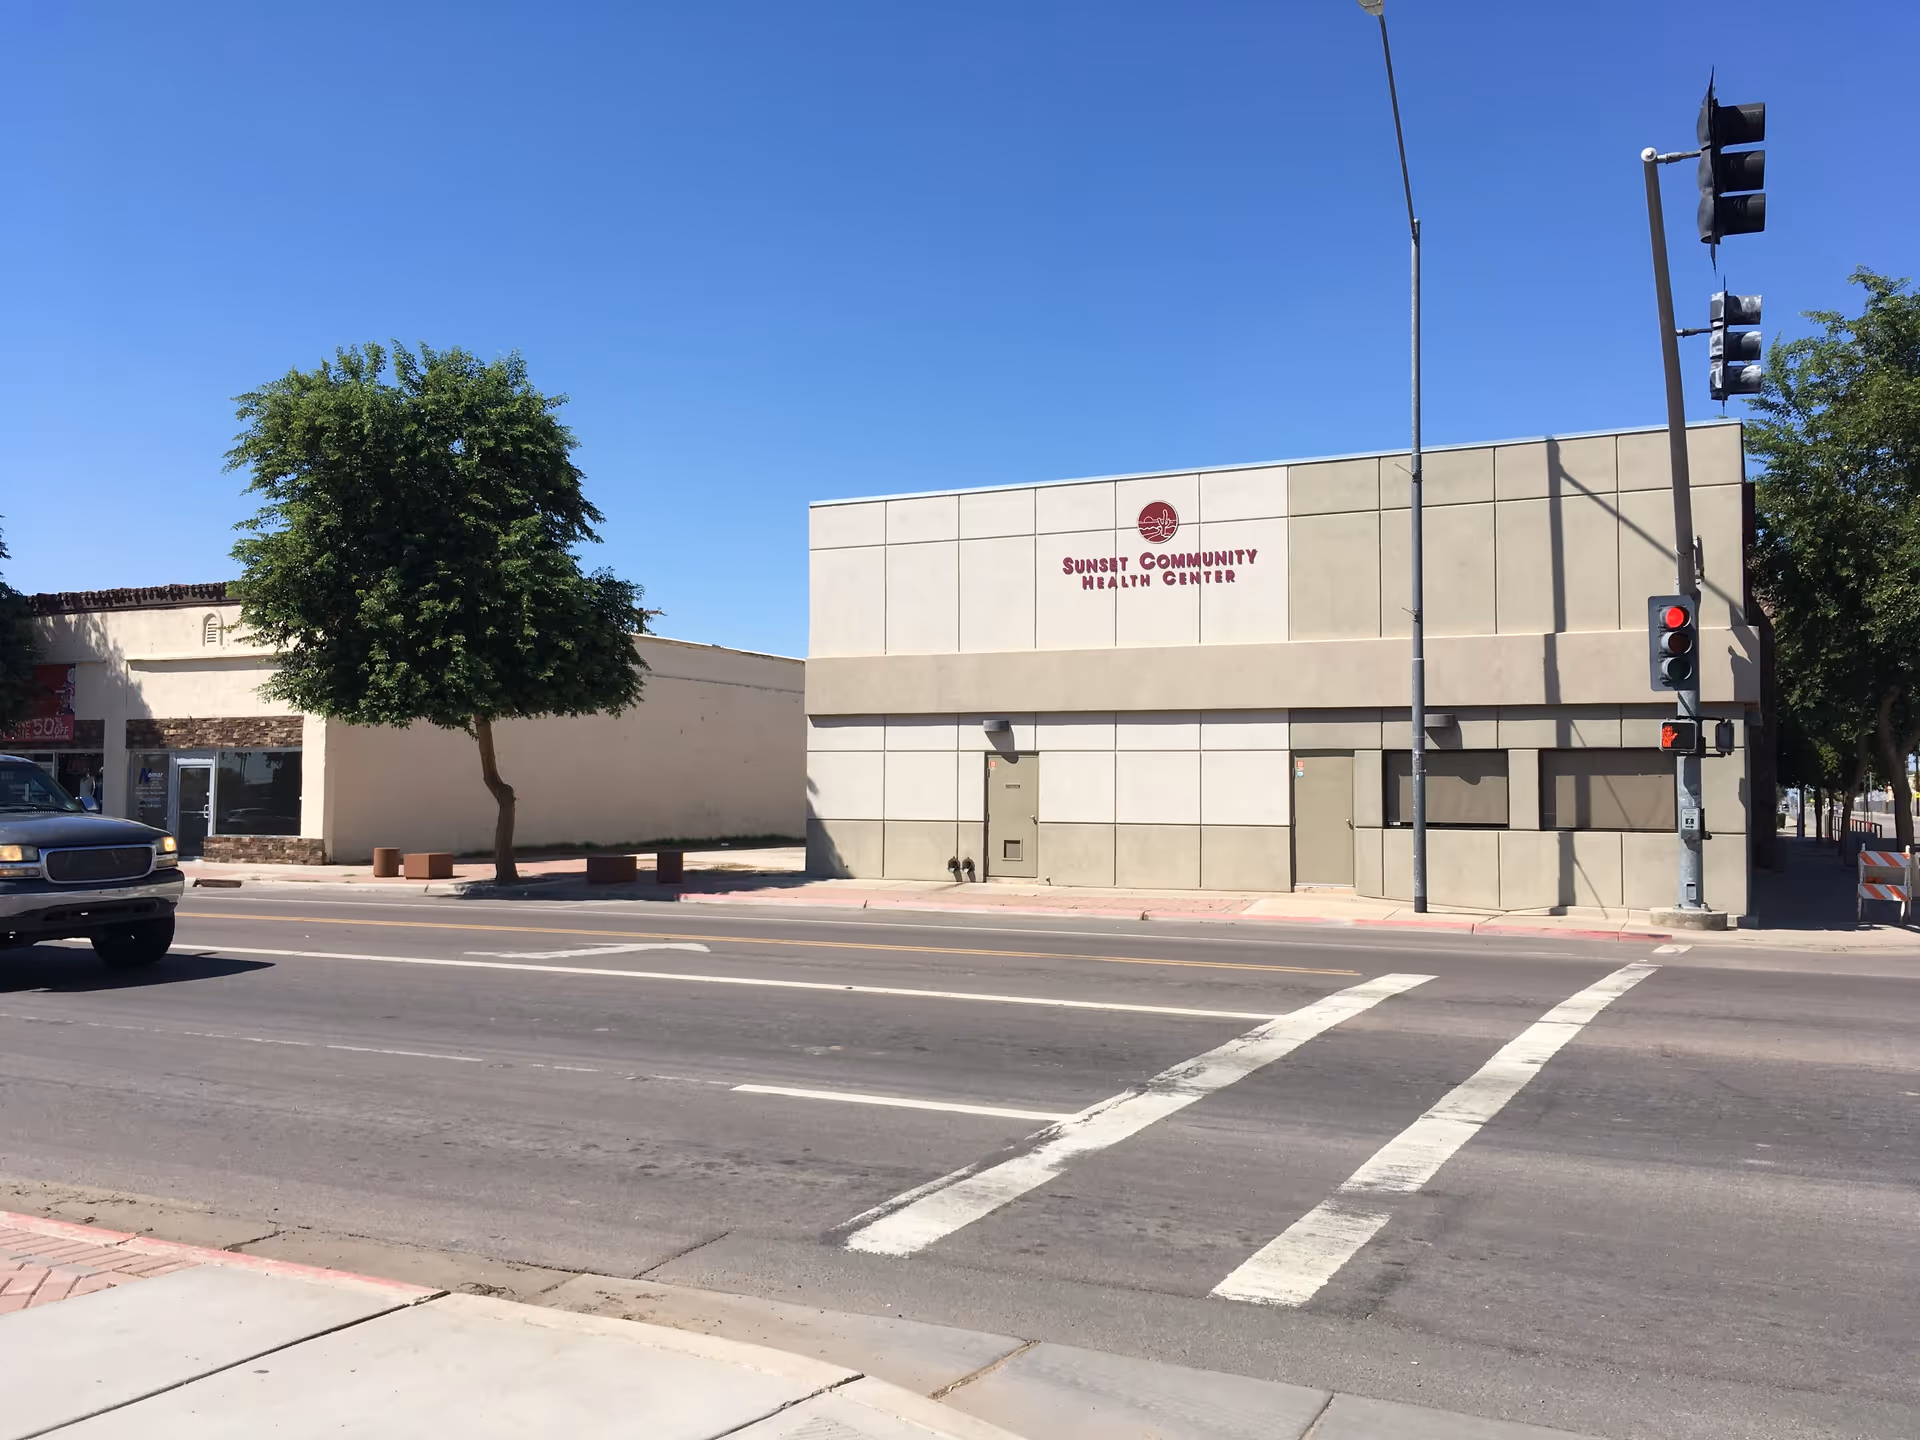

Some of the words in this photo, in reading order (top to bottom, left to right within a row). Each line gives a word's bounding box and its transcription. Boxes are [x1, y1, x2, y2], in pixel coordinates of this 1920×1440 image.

[1062, 556, 1128, 575] SUNSET
[1139, 549, 1258, 570] COMMUNITY
[1082, 573, 1150, 590] HEALTH
[1162, 569, 1236, 586] CENTER
[54, 726, 69, 735] OFF
